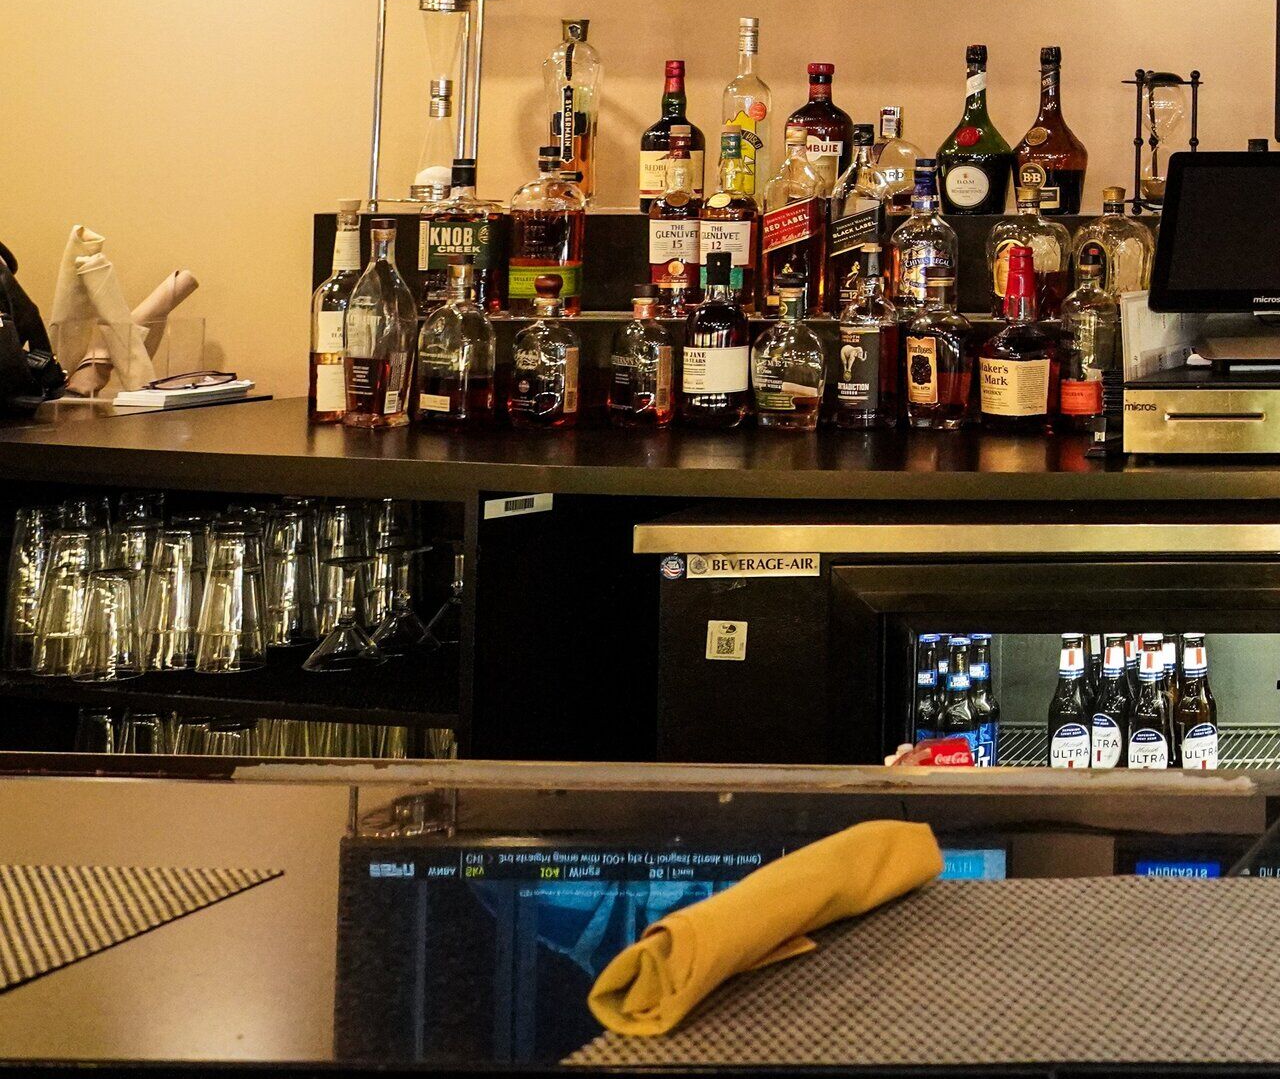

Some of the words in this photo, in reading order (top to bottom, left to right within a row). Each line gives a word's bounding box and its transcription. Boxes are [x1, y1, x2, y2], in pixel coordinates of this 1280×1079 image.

[764, 223, 780, 234] RED
[781, 214, 810, 228] LABEL
[832, 229, 854, 239] BLACK
[855, 220, 878, 232] LABEL
[430, 227, 473, 247] KNOB
[656, 230, 700, 240] GLENLIVET
[437, 245, 481, 254] CREEK
[672, 240, 684, 250] 15
[711, 241, 722, 250] 12
[984, 375, 1009, 386] Mark
[1125, 401, 1157, 411] micros
[712, 557, 813, 571] BEVERAGE-AIR
[1052, 748, 1090, 759] ULTRA
[1131, 753, 1166, 764] ULTRA
